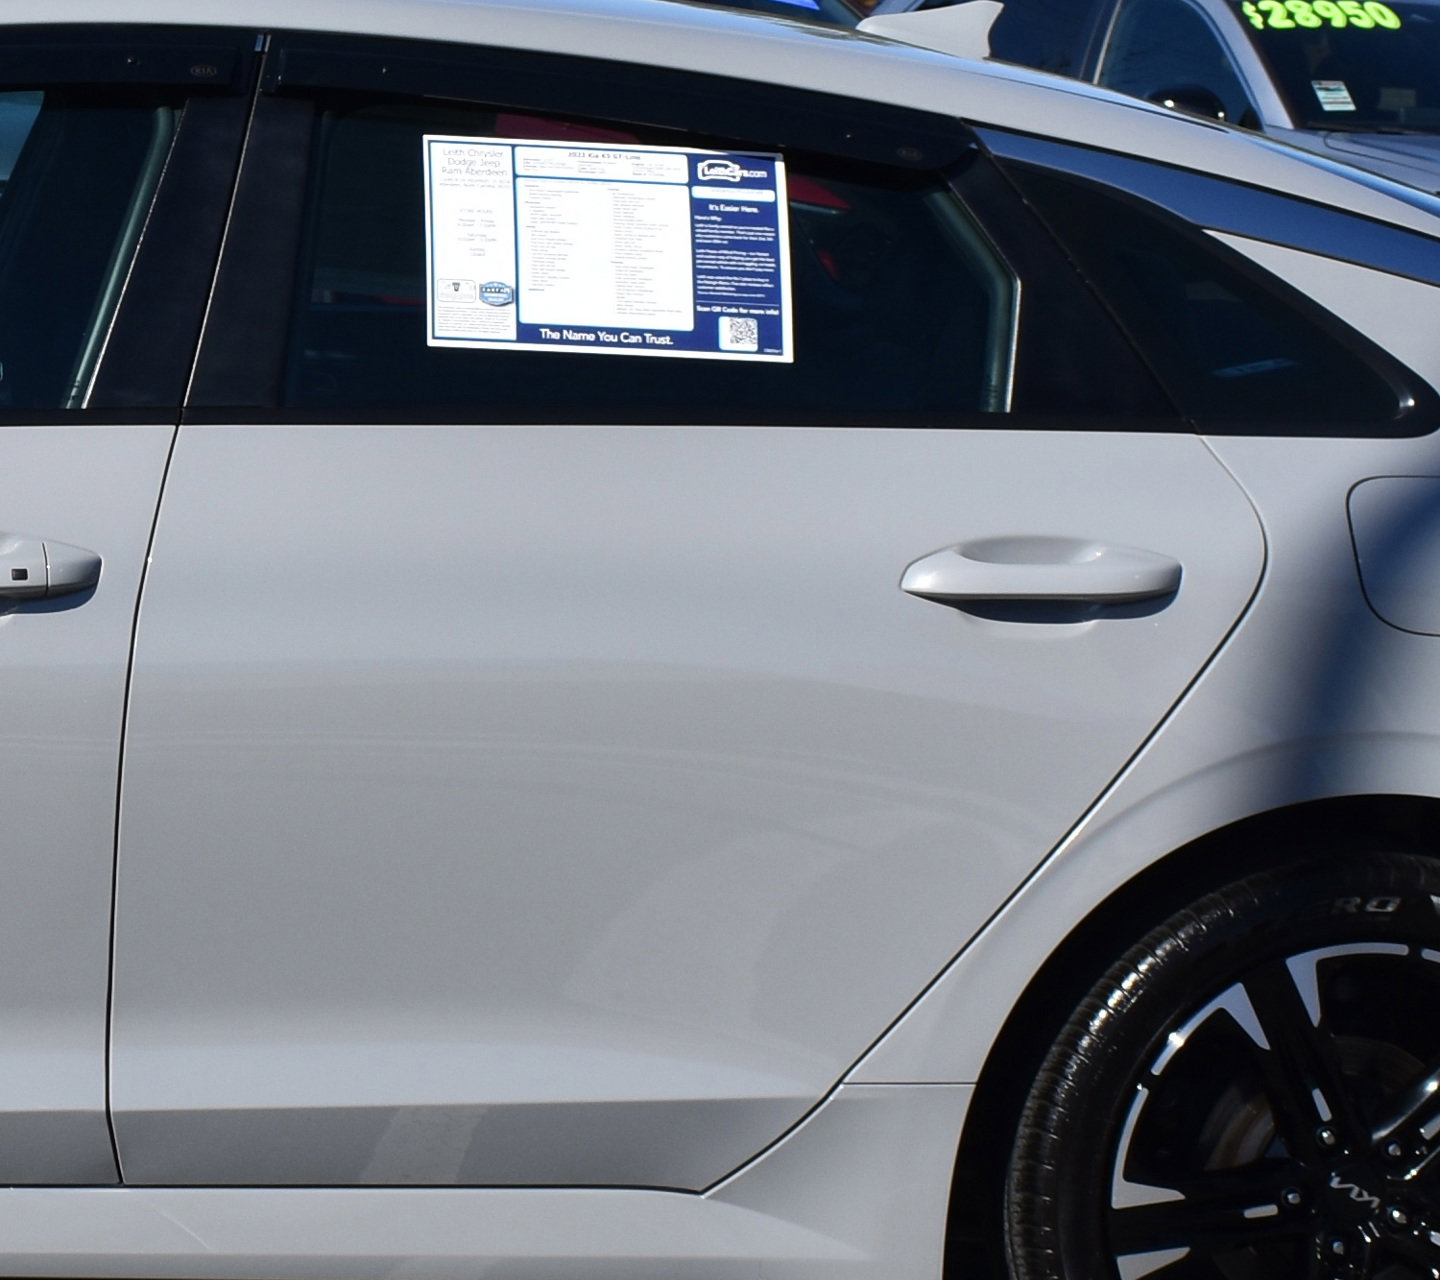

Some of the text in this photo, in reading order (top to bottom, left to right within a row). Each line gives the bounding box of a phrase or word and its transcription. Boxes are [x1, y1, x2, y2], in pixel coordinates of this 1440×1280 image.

[1241, 0, 1401, 30] $28950
[539, 328, 674, 345] The Name You Can Trust.
